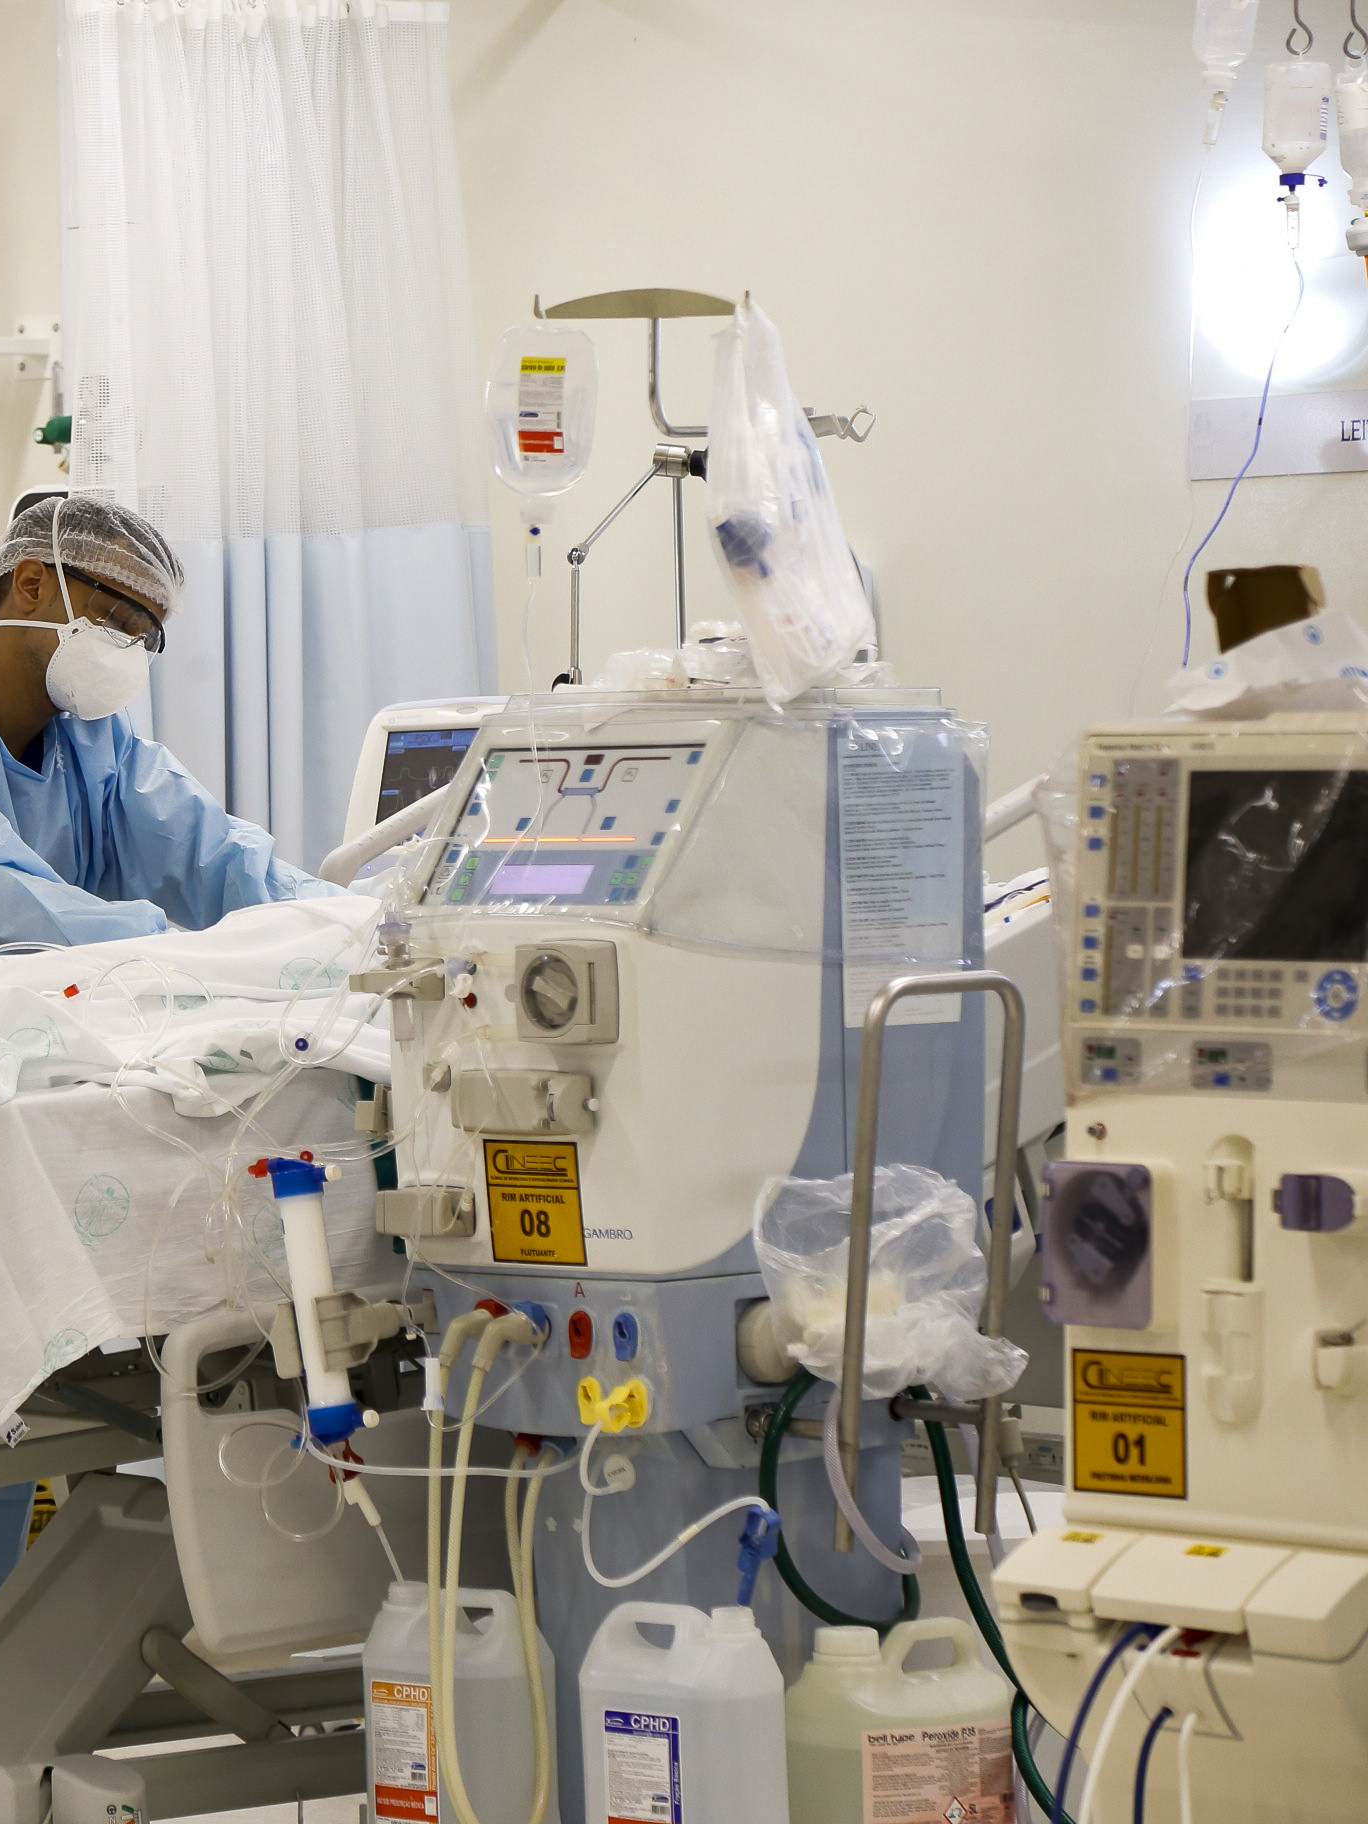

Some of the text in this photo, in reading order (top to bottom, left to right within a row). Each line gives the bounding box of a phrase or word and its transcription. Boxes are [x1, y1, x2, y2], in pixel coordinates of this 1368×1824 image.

[1341, 419, 1368, 441] LEI
[501, 1192, 566, 1205] RIM ARTIFICIAL
[520, 1209, 551, 1239] 08
[583, 1228, 633, 1240] GAMBRO
[520, 1248, 556, 1258] FLUTUANTE
[574, 1281, 586, 1298] A
[1113, 1432, 1147, 1467] 01
[393, 1685, 429, 1701] CPHD
[630, 1715, 670, 1732] CPHD
[921, 1730, 960, 1742] Peroxide
